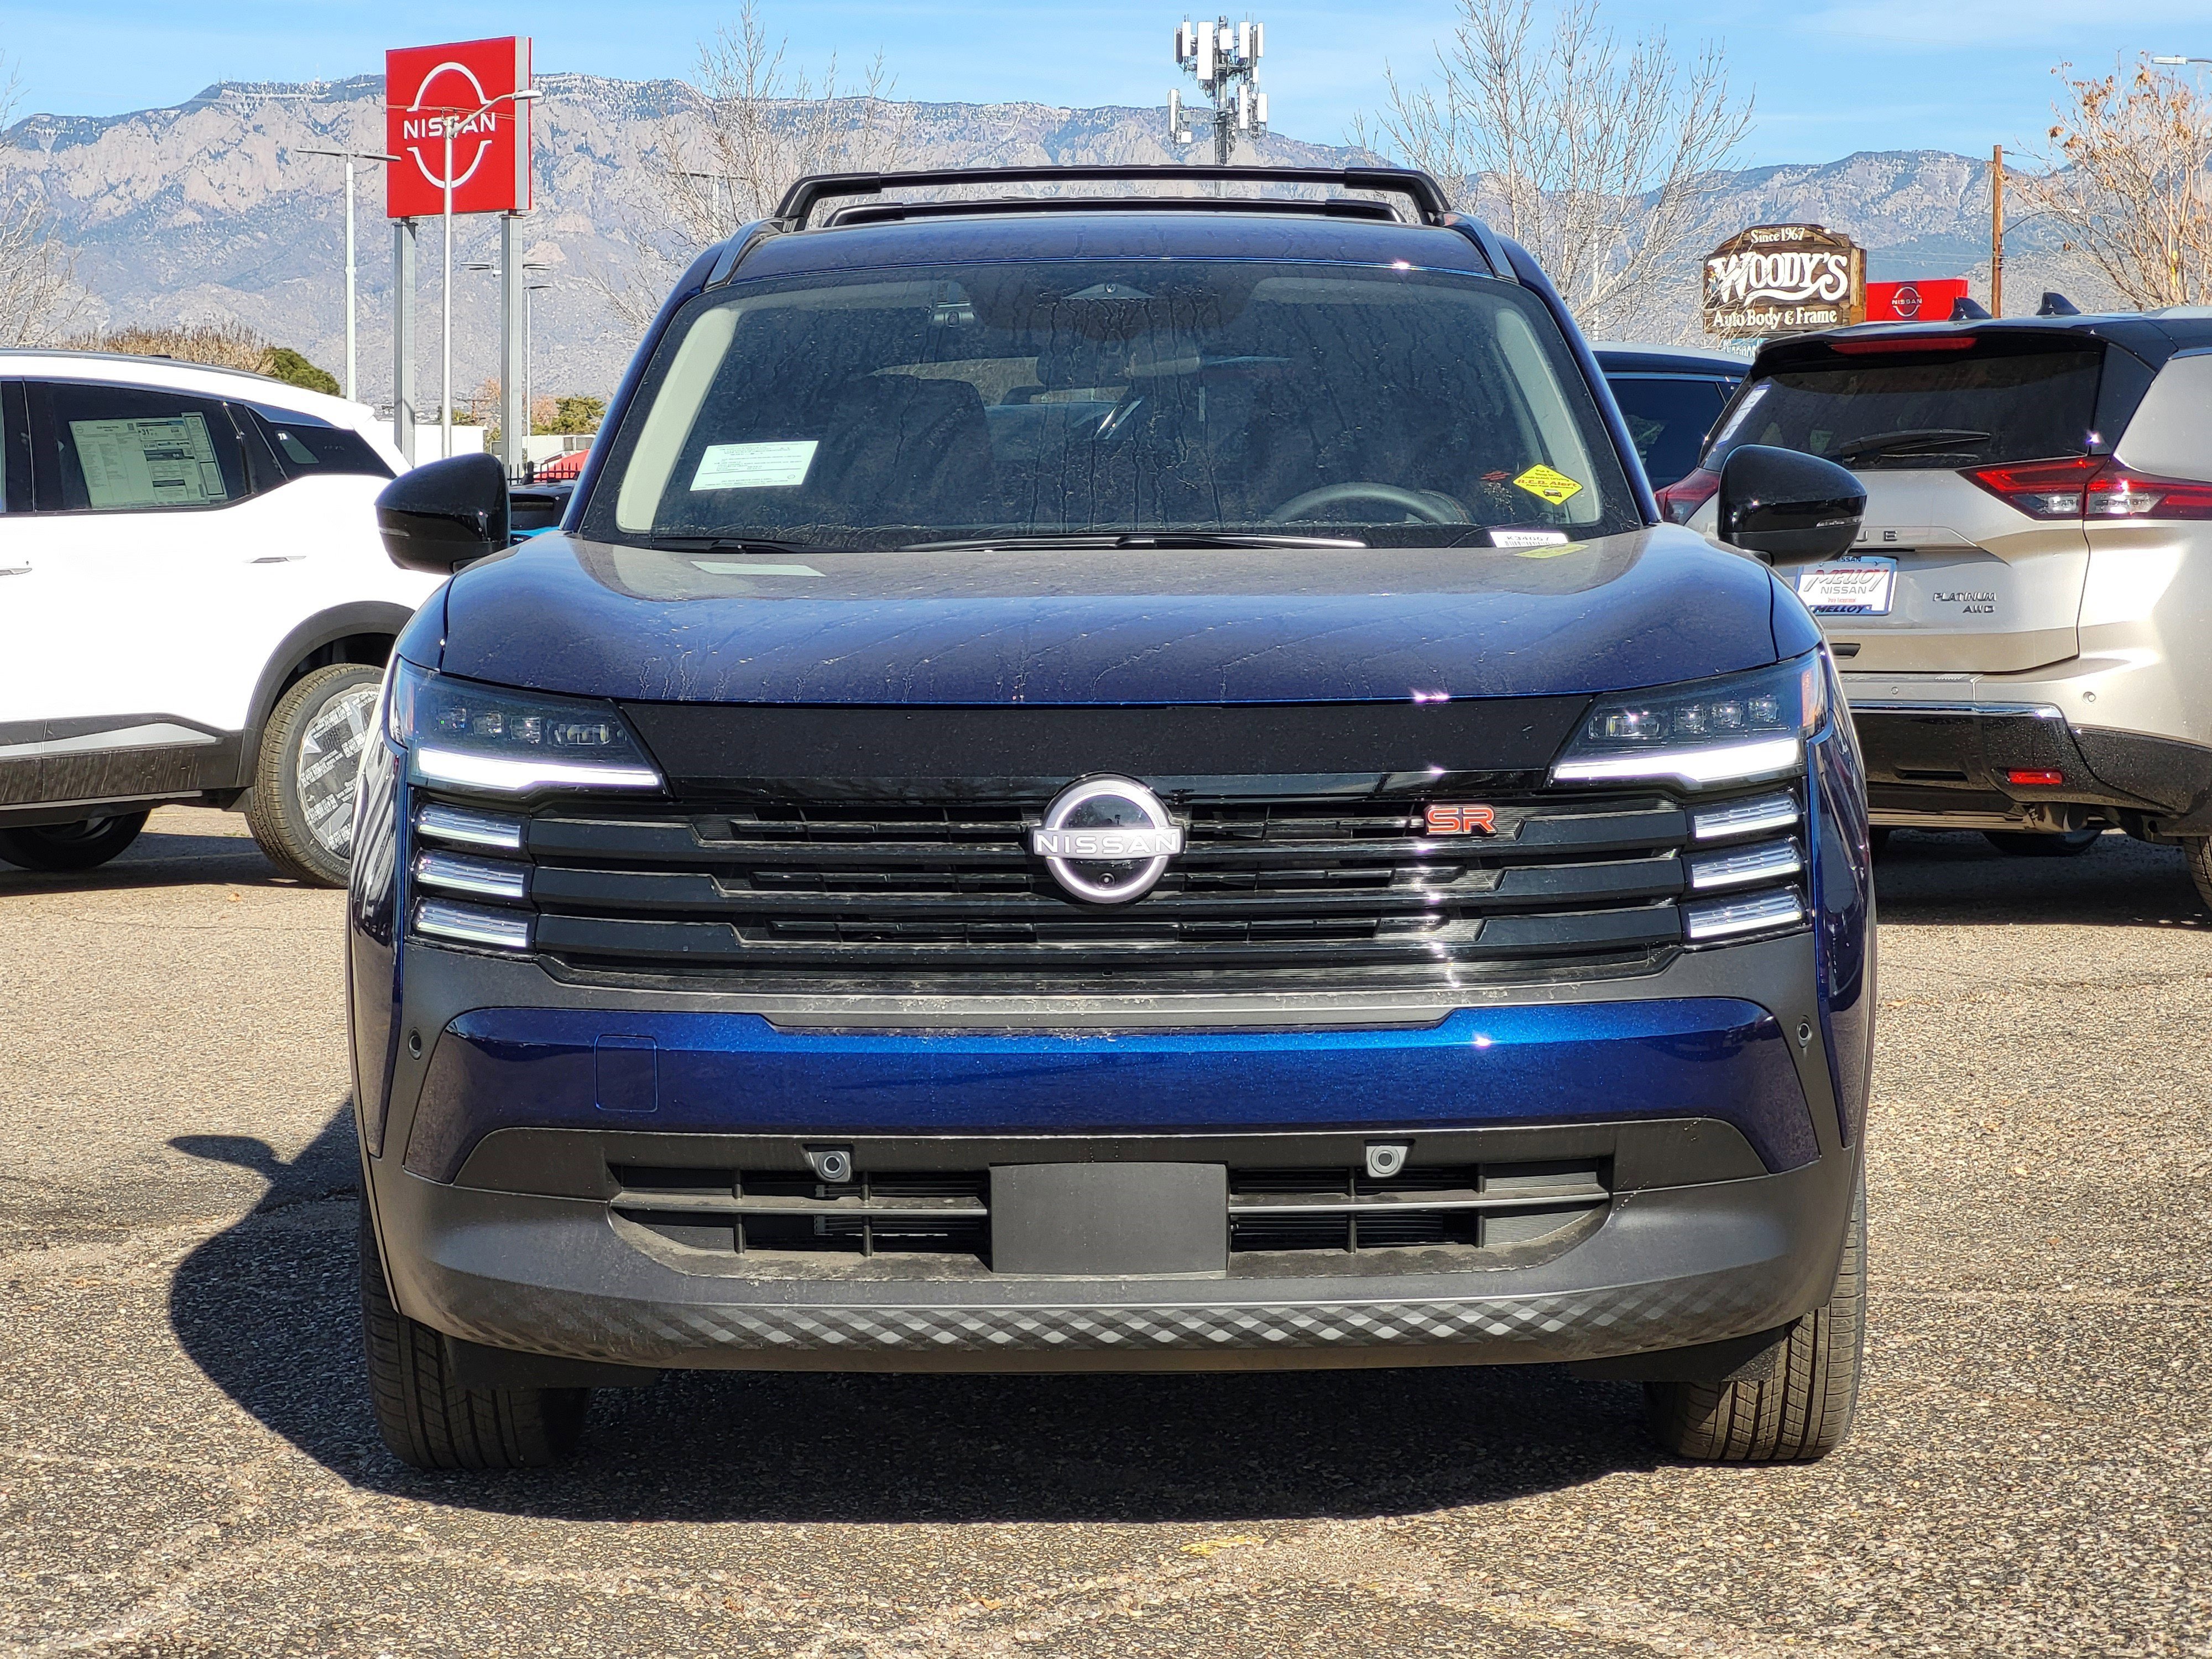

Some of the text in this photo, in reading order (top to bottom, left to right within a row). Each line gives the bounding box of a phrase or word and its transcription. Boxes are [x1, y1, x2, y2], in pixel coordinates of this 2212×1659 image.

[1750, 227, 1806, 244] Since 1967
[1707, 251, 1848, 306] WOODY'S
[1713, 306, 1838, 330] Auto Body & Frame
[1933, 592, 1997, 602] PLATINUM
[1813, 605, 1864, 614] MELLOY
[1962, 605, 1995, 613] AWD
[1426, 804, 1496, 835] SR
[1035, 832, 1178, 854] NISSAN
